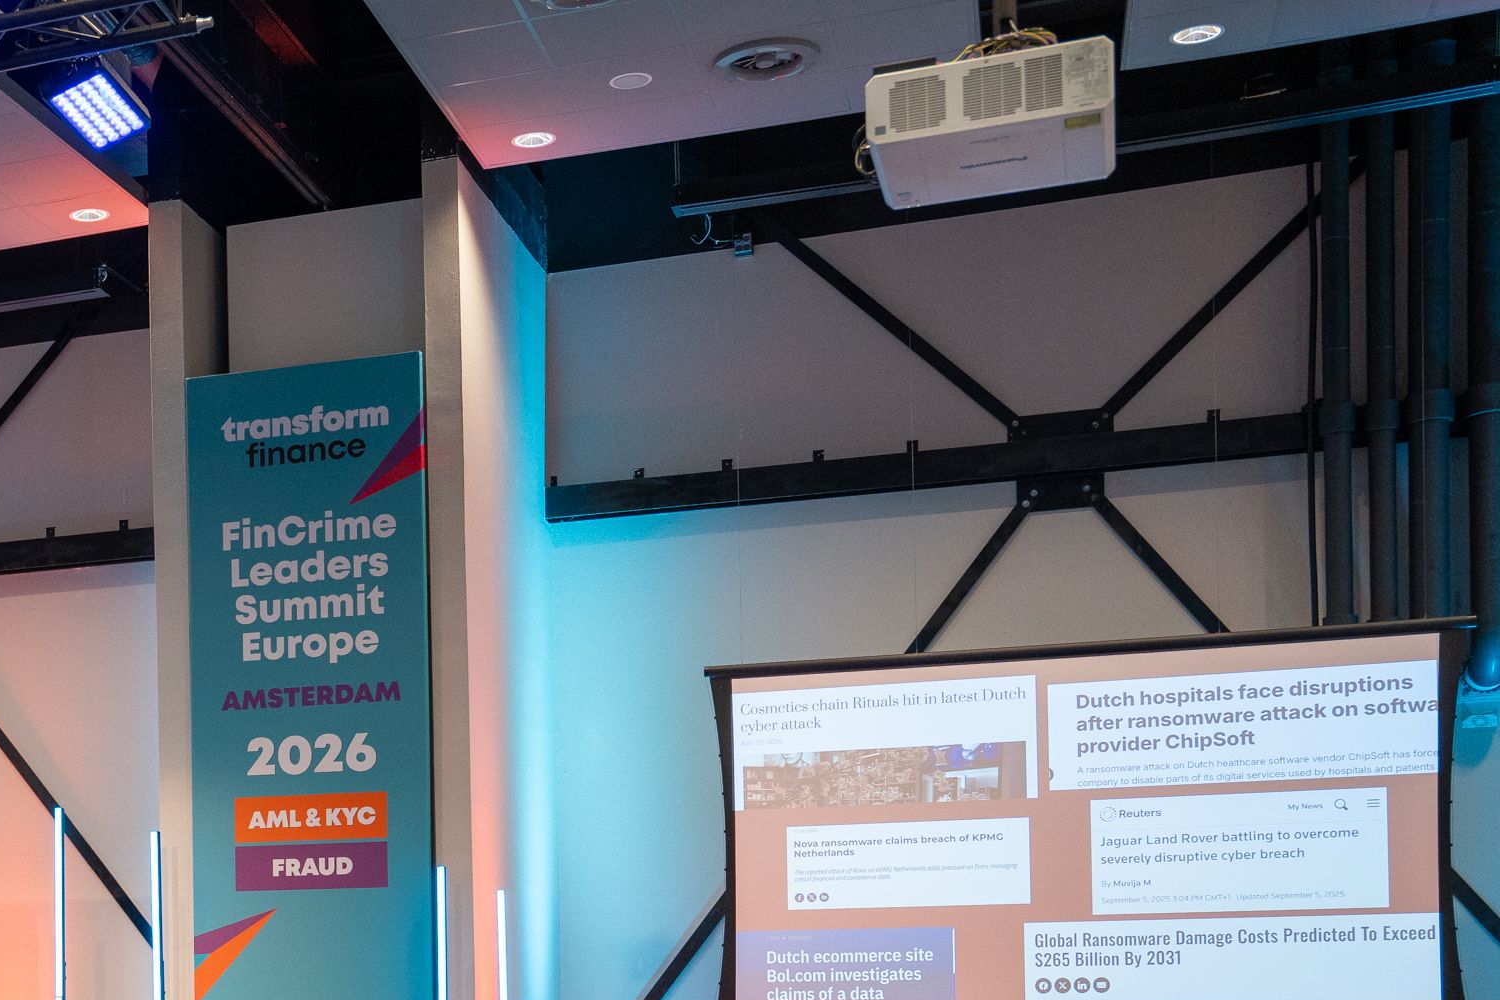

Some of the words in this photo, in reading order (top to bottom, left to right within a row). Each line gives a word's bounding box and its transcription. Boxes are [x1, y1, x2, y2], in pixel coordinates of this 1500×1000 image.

[221, 405, 389, 442] transform
[246, 438, 366, 468] finance
[222, 510, 396, 551] FinCrime
[231, 550, 389, 588] Leaders
[235, 583, 385, 625] Summit
[242, 630, 379, 664] Europe
[222, 681, 401, 711] AMSTERDAM
[740, 701, 809, 715] Cosmetics
[812, 698, 848, 711] chain
[853, 695, 899, 709] Rituals
[903, 693, 920, 706] hit
[924, 693, 937, 705] in
[941, 691, 978, 704] latest
[983, 687, 1026, 701] Dutch
[1076, 692, 1134, 709] Dutch
[1140, 686, 1233, 706] hospitals
[1237, 684, 1284, 700] face
[1289, 676, 1413, 697] disruptions
[740, 719, 778, 736] cyber
[781, 716, 821, 730] attack
[1076, 715, 1123, 732] after
[1128, 710, 1255, 729] ransomware
[1260, 703, 1327, 721] attack
[1332, 704, 1358, 717] on
[1364, 698, 1438, 715] softwa
[247, 732, 376, 776] 2026
[1077, 736, 1161, 758] provider
[1165, 730, 1255, 750] ChipSoft
[1077, 766, 1084, 774] A
[1086, 765, 1141, 774] ransomware
[1143, 762, 1170, 771] attack
[1187, 760, 1214, 769] Dutch
[1217, 759, 1266, 767] healthcare
[1268, 756, 1309, 765] software
[1312, 754, 1346, 763] vendor
[1348, 750, 1390, 762] ChipSoft
[1413, 749, 1438, 757] force
[248, 809, 302, 829] AML
[305, 808, 321, 827] &
[326, 806, 376, 826] KYC
[1119, 809, 1162, 818] Reuters
[821, 839, 883, 847] ransomware
[885, 836, 918, 845] claims
[921, 834, 956, 843] breach
[959, 834, 969, 842] of
[972, 833, 1003, 842] KPMG
[1100, 837, 1142, 849] Jaguar
[1146, 834, 1177, 845] Land
[1181, 833, 1218, 843] Rover
[1222, 831, 1273, 843] battling
[1277, 831, 1290, 840] to
[1294, 829, 1359, 839] overcome
[794, 848, 855, 858] Netherlands
[1101, 853, 1151, 865] severely
[1154, 851, 1218, 864] disruptive
[1221, 850, 1256, 863] cyber
[1260, 847, 1305, 859] breach
[272, 856, 353, 877] FRAUD
[1113, 880, 1141, 888] Muvija
[1035, 933, 1077, 948] Global
[1083, 932, 1170, 947] Ransomware
[1176, 930, 1232, 946] Damage
[1238, 929, 1278, 944] Costs
[1284, 926, 1355, 943] Predicted
[1361, 926, 1377, 941] To
[1383, 924, 1436, 941] Exceed
[767, 949, 809, 964] Dutch
[814, 951, 901, 963] ecommerce
[906, 947, 933, 962] site
[1035, 952, 1070, 968] $265
[1075, 952, 1119, 967] Billion
[1125, 951, 1142, 968] By
[1147, 950, 1180, 965] 2031
[767, 968, 826, 983] Bol.com
[830, 967, 922, 984] investigates
[767, 987, 815, 1000] claims
[819, 986, 833, 1000] of
[837, 990, 846, 1000] a
[850, 986, 884, 1000] data
